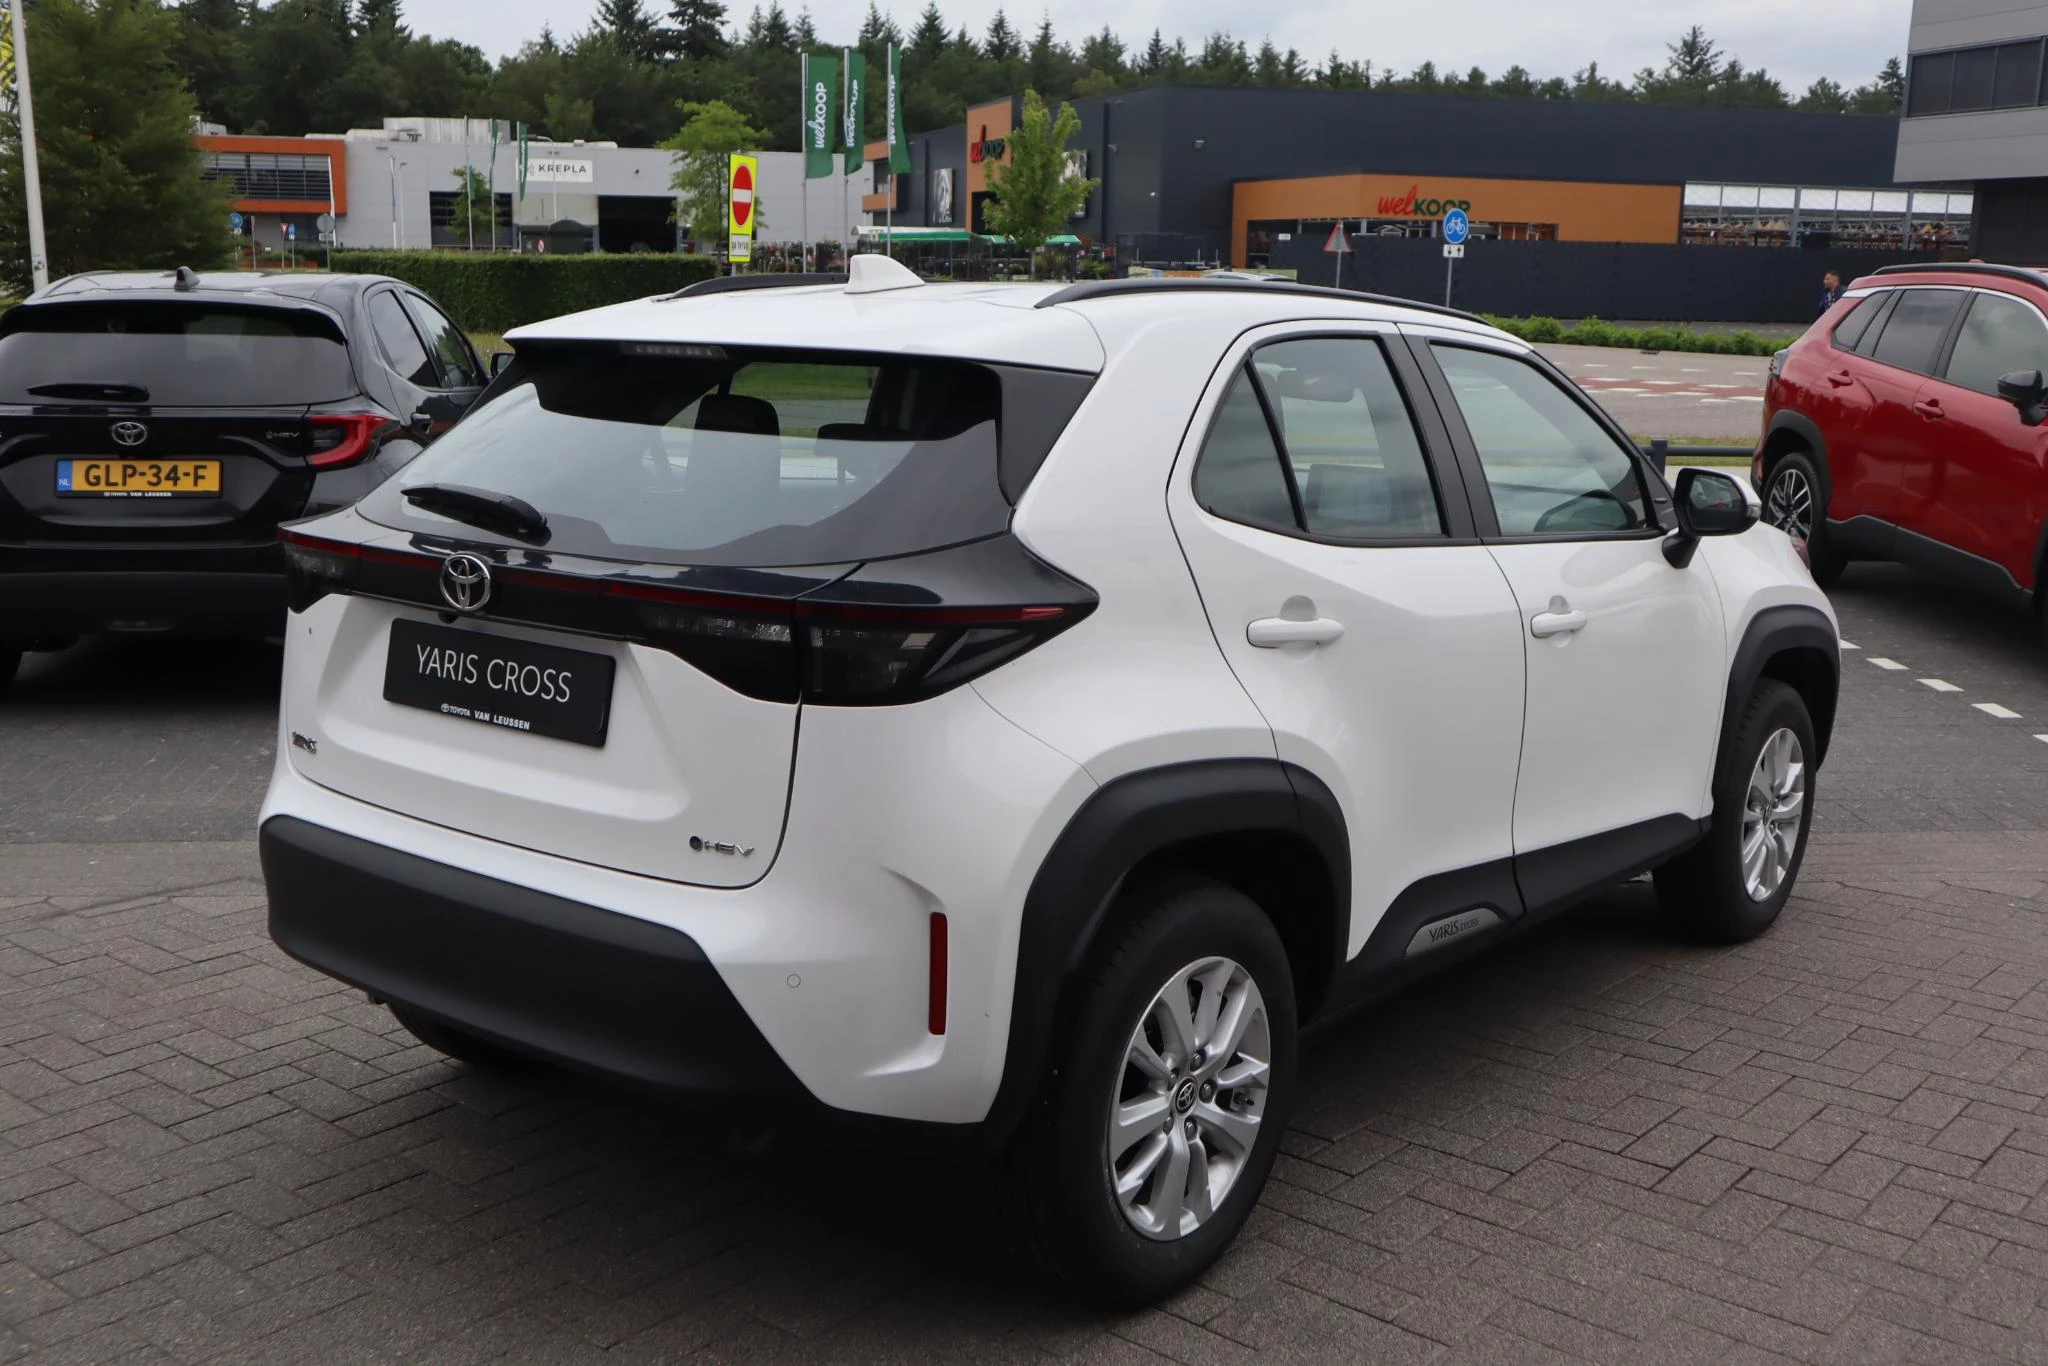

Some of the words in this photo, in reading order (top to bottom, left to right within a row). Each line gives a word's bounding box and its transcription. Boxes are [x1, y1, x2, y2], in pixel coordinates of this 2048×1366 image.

[538, 164, 587, 174] KREPLA
[58, 478, 70, 487] NL
[84, 463, 208, 488] GLP-34-F
[416, 643, 479, 685] YARIS
[486, 658, 572, 703] CROSS
[449, 705, 471, 718] TOYOTA
[474, 710, 490, 723] VAN
[493, 714, 531, 731] LEUSSEN
